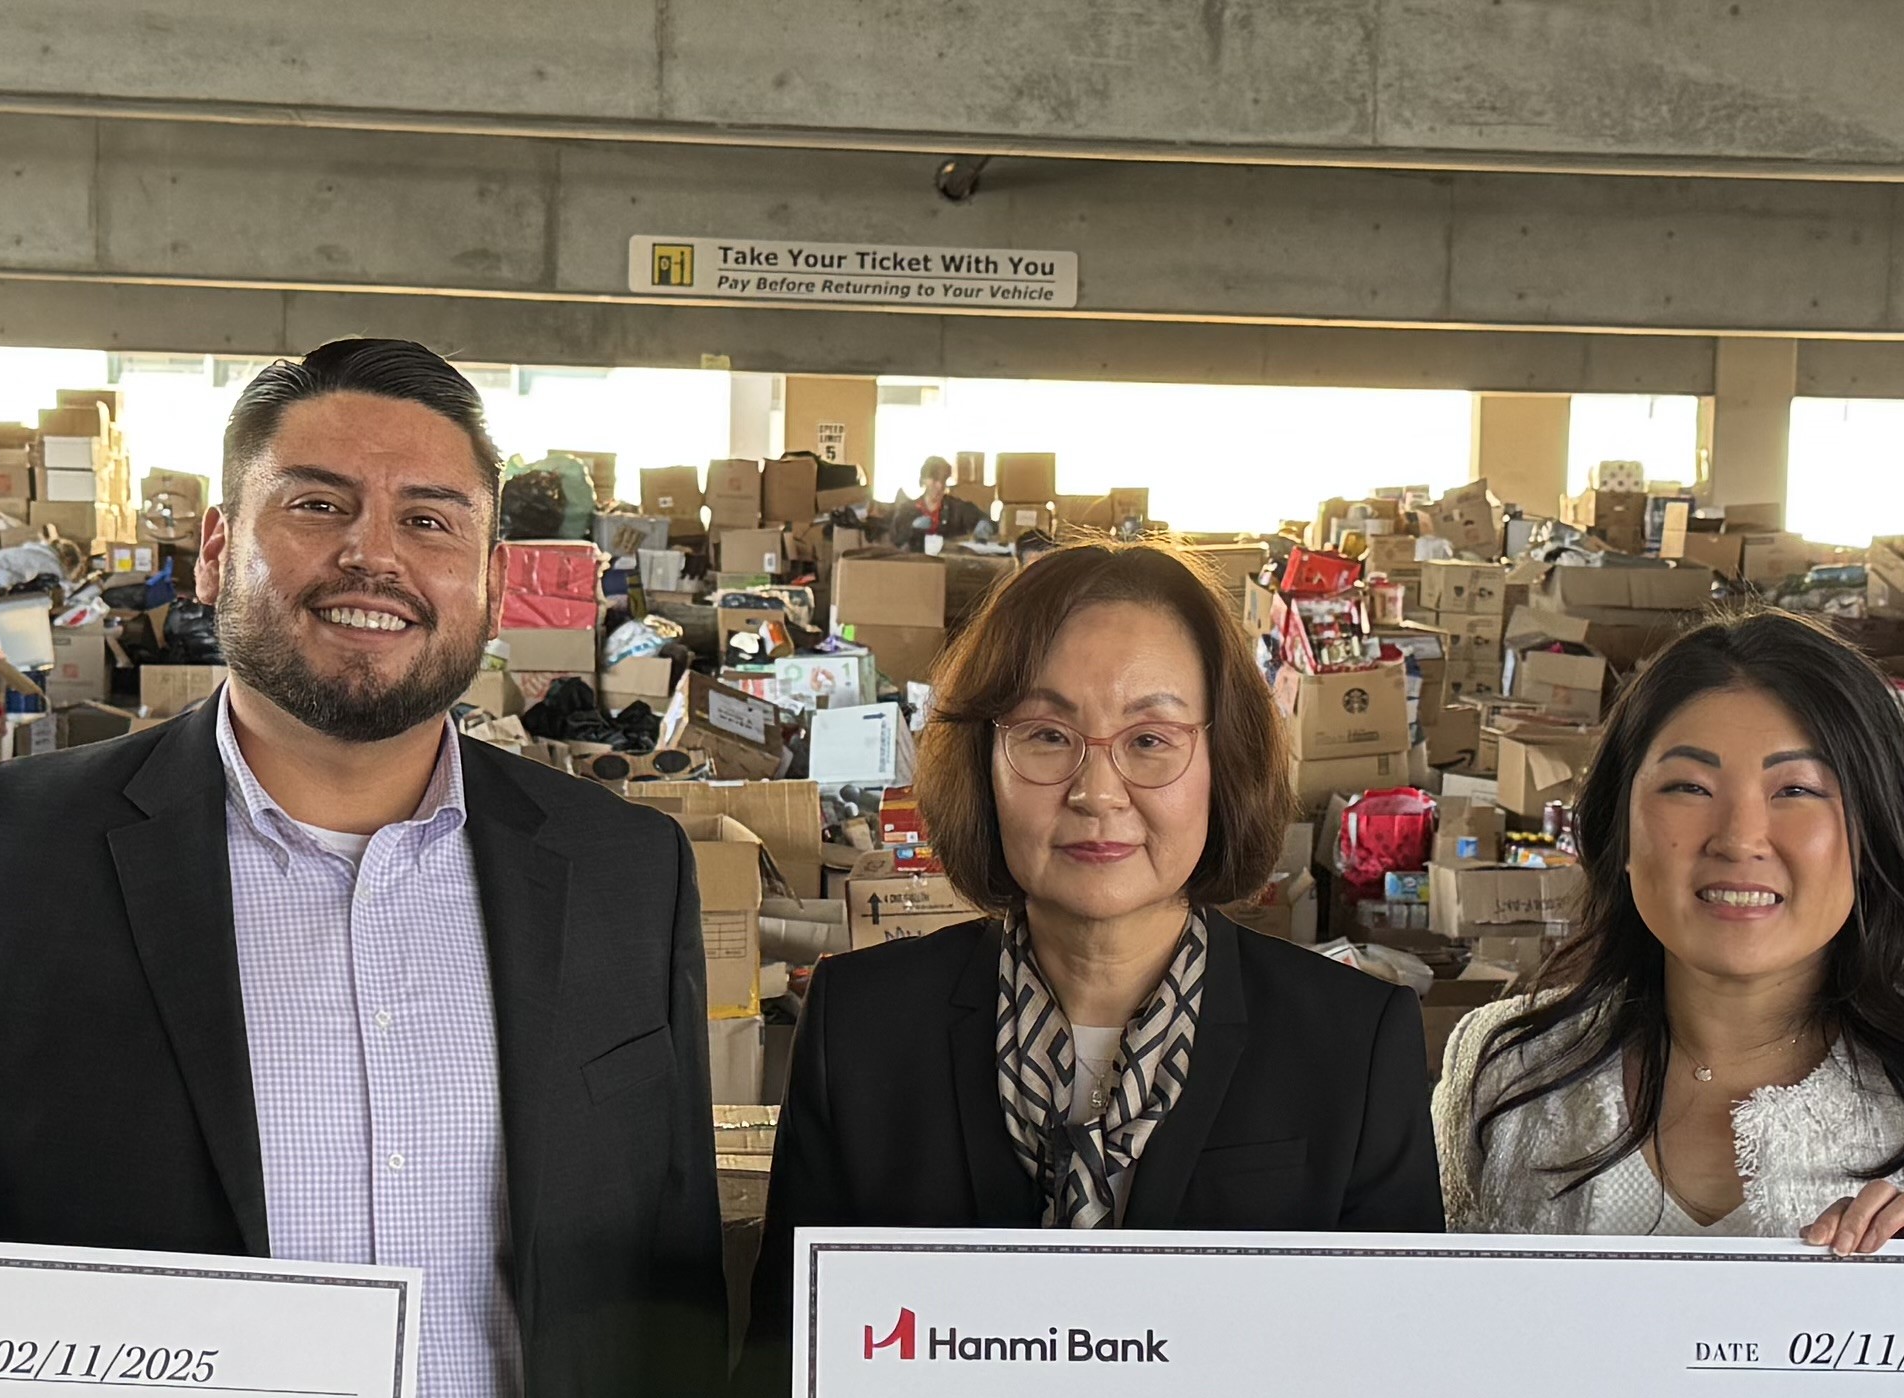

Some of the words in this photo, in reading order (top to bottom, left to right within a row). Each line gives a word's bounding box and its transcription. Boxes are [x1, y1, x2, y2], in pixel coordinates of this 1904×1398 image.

[717, 246, 778, 266] Take
[787, 248, 847, 269] Your
[855, 250, 932, 273] Ticket
[940, 253, 998, 275] With
[1008, 256, 1055, 277] You
[717, 276, 749, 293] Pay
[756, 277, 814, 295] Before
[821, 279, 910, 299] Returning
[916, 282, 935, 298] to
[942, 283, 984, 300] Your
[989, 285, 1053, 301] Vehicle
[825, 445, 836, 460] 5
[928, 1326, 1057, 1363] Hanmi
[1067, 1328, 1169, 1364] Bank
[1696, 1342, 1759, 1363] DATE
